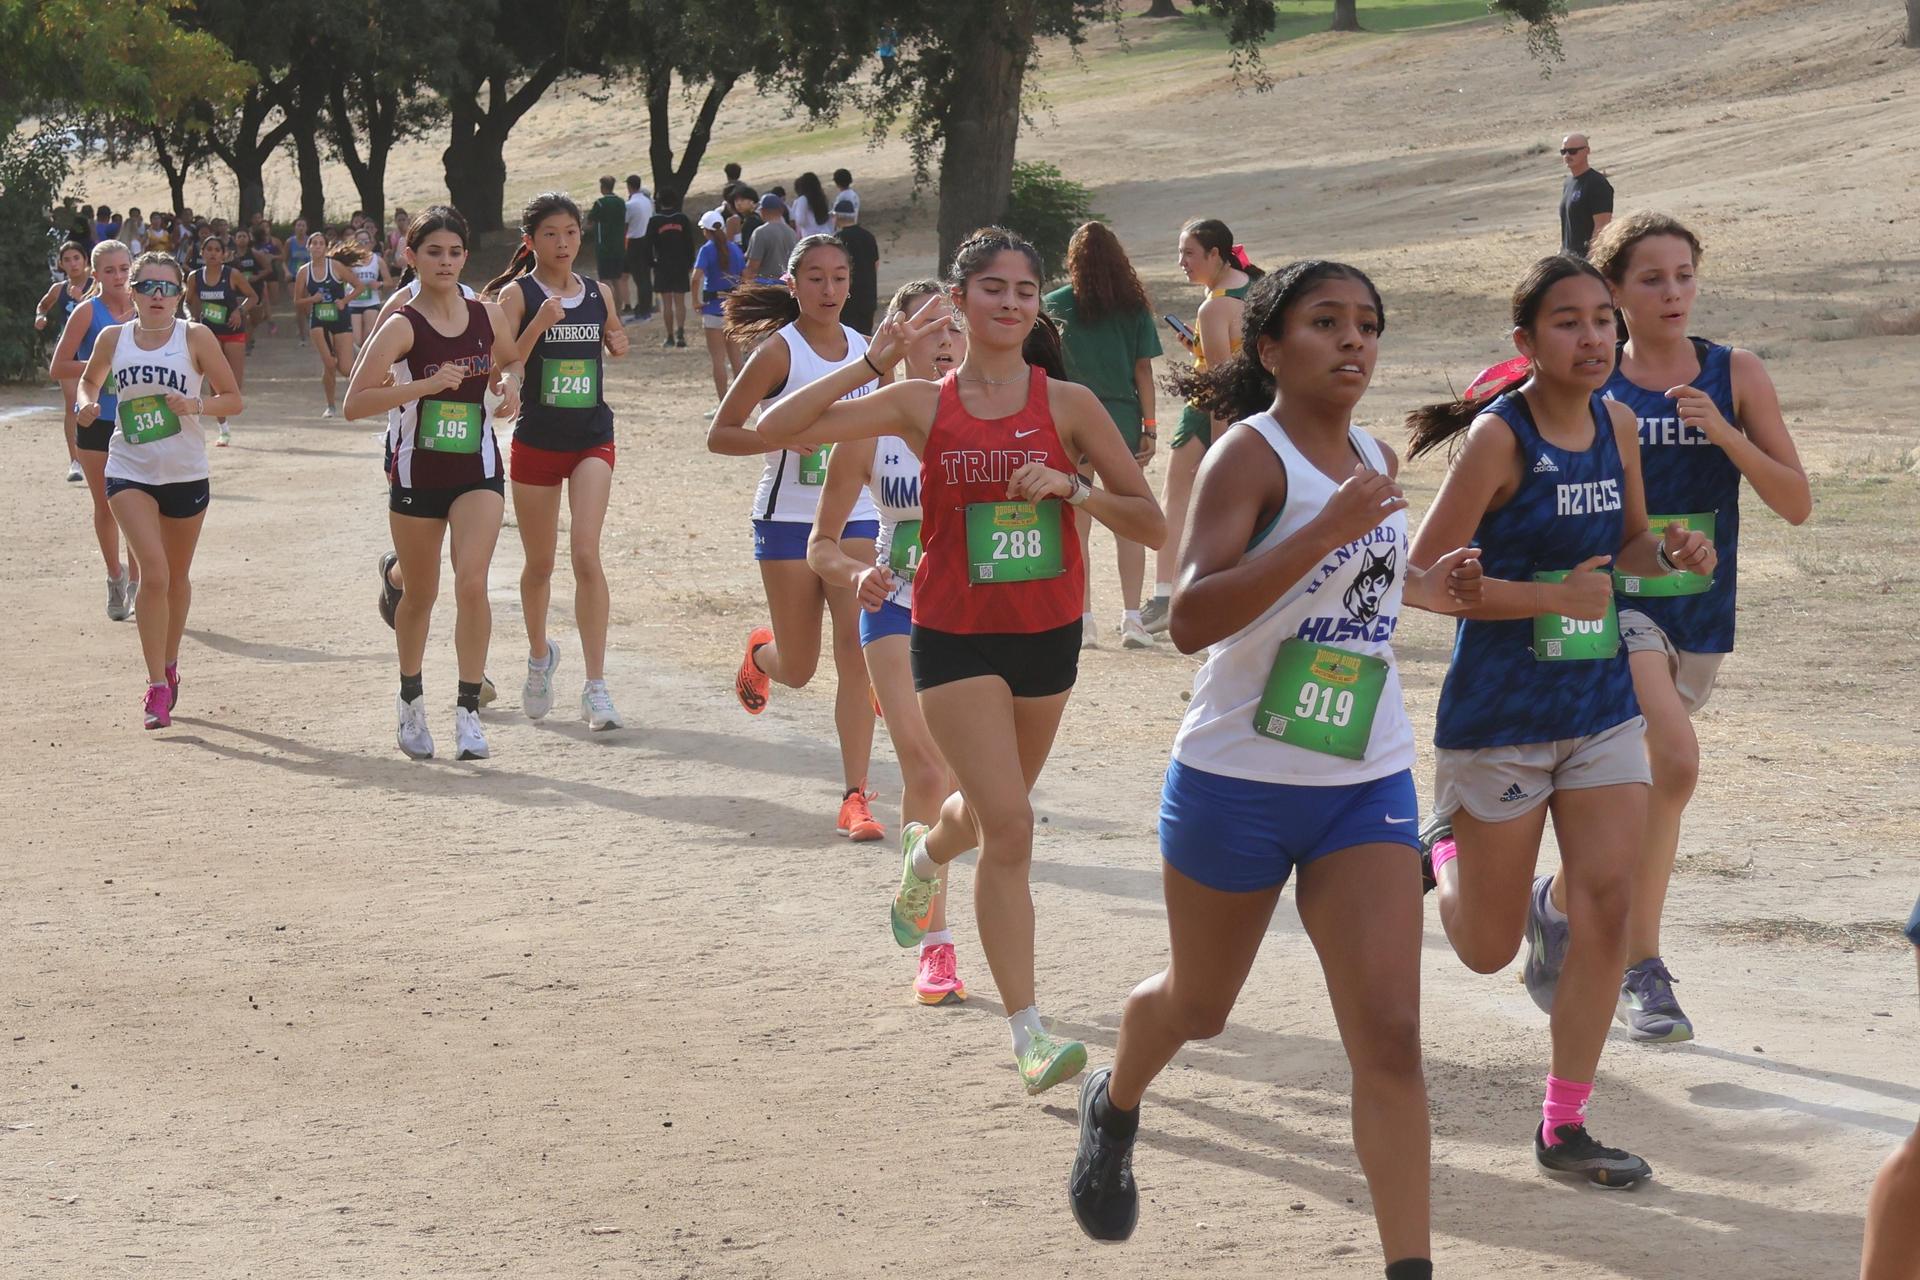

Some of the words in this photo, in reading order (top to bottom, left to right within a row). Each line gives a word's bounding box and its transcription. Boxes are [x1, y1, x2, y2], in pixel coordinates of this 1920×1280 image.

[545, 326, 600, 341] LYNBROOK
[551, 376, 590, 394] 1249
[134, 409, 165, 432] 334
[436, 419, 468, 439] 195
[1557, 478, 1621, 516] AZTECS
[992, 529, 1042, 561] 288
[1295, 682, 1354, 727] 919
